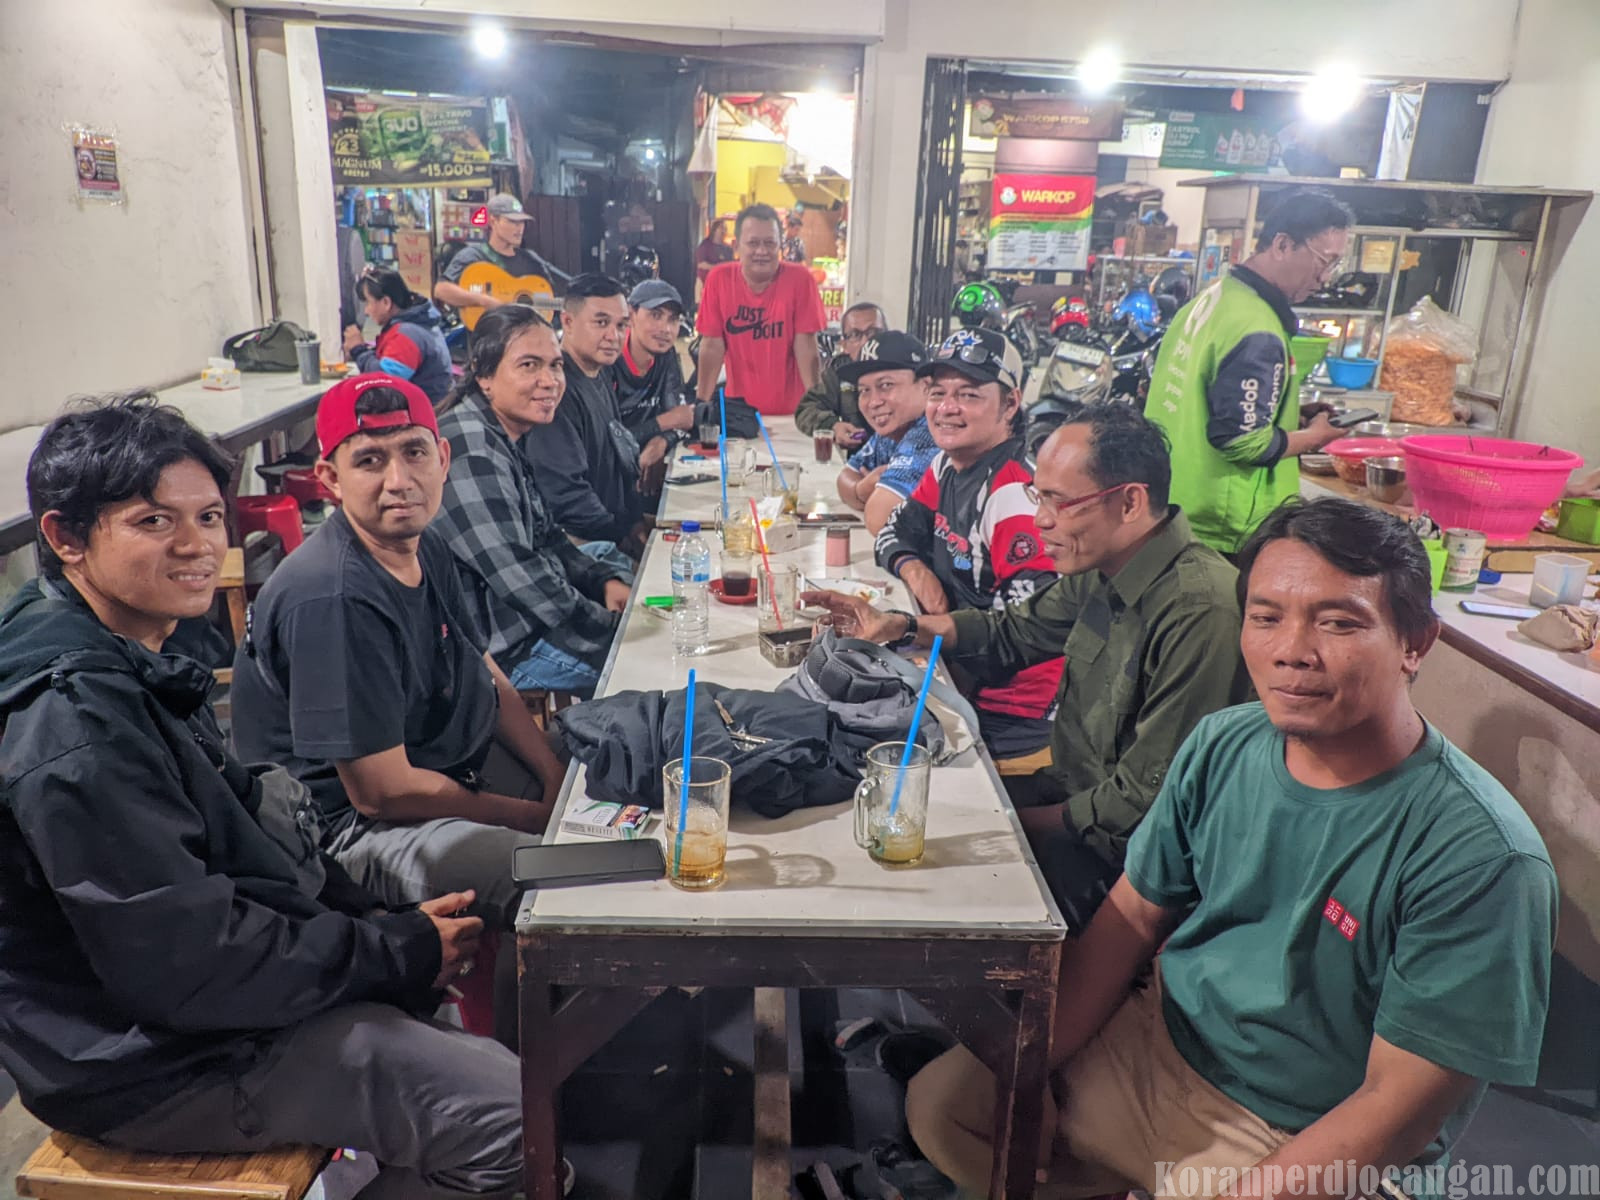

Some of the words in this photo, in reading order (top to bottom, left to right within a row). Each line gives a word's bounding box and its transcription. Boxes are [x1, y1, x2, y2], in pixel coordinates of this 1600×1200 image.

[427, 163, 474, 177] 15.000
[1021, 189, 1077, 204] WARKOP
[733, 304, 766, 322] JUST
[1240, 378, 1260, 431] gopay
